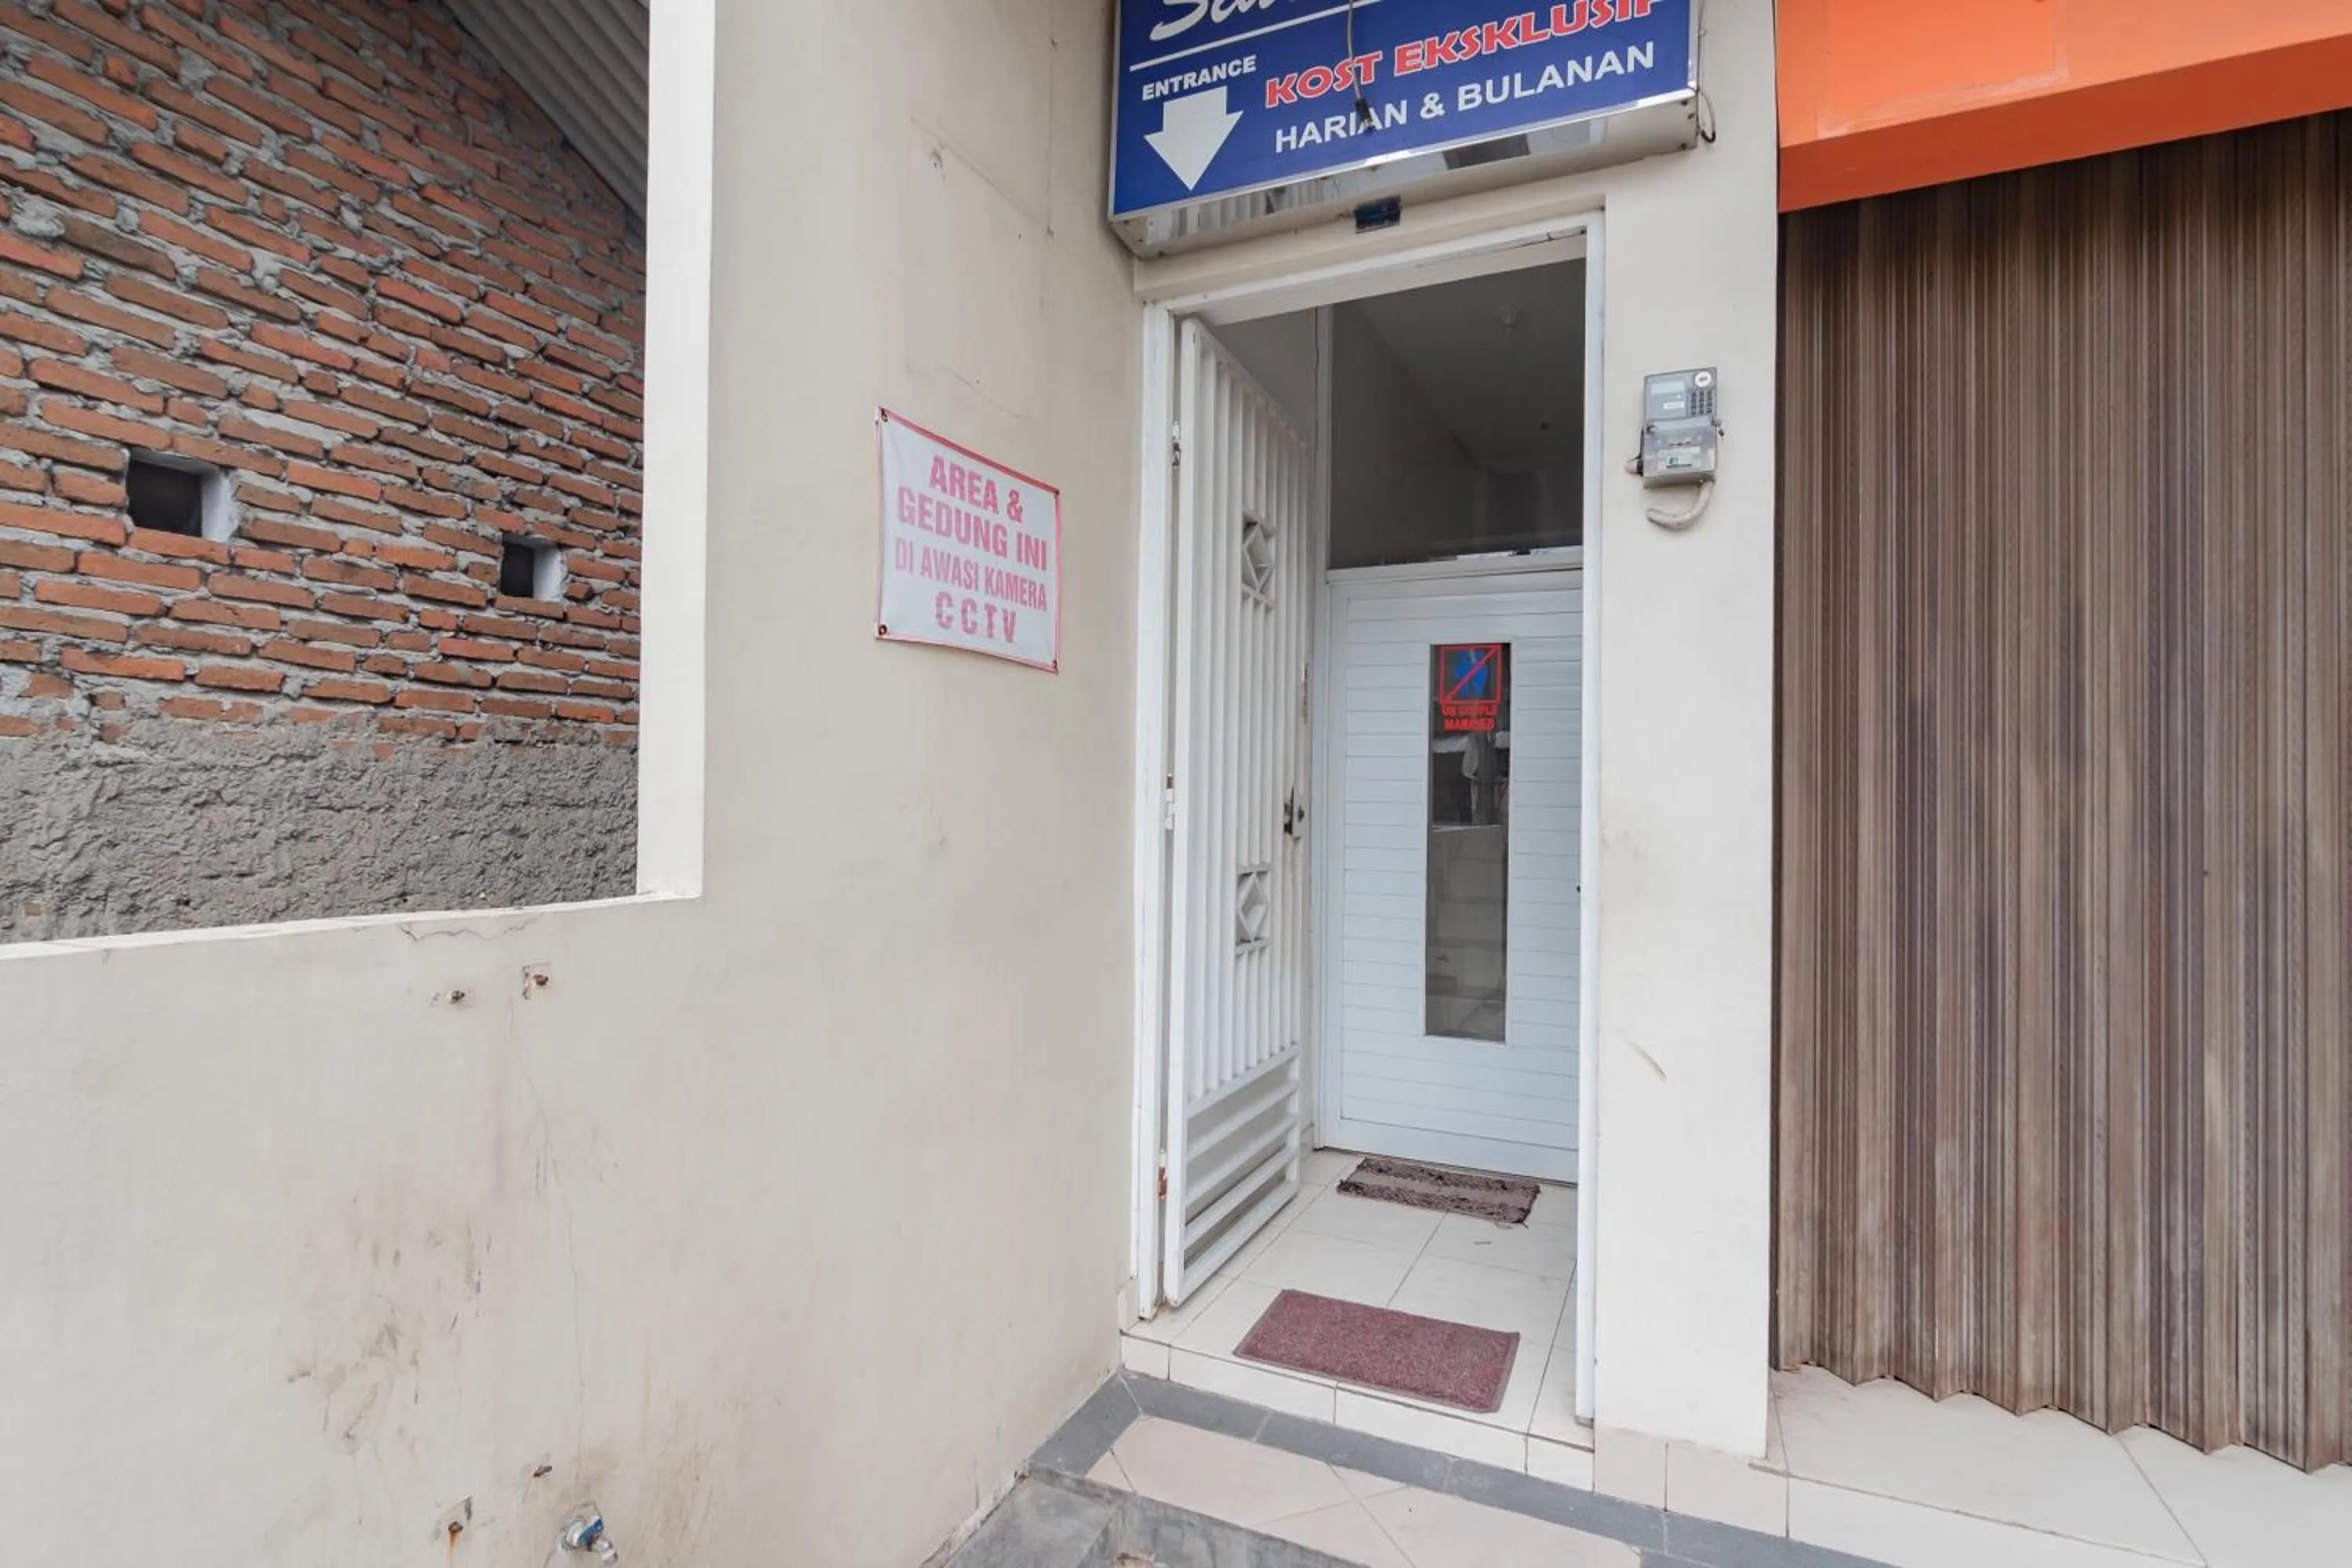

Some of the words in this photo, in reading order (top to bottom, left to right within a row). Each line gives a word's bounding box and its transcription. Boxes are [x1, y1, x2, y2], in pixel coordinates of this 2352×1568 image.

[1142, 54, 1258, 102] ENTRANCE
[1265, 50, 1382, 109] KOST
[1275, 100, 1408, 154] HARIAN
[1419, 92, 1446, 119] &
[1457, 41, 1654, 112] BULANAN
[929, 455, 999, 515] AREA
[1006, 488, 1023, 524] &
[896, 485, 1007, 559] GEDUNG
[1016, 529, 1047, 572] INI
[895, 537, 914, 574] DI
[920, 546, 979, 592] AWASI
[984, 564, 1047, 612] KAMERA
